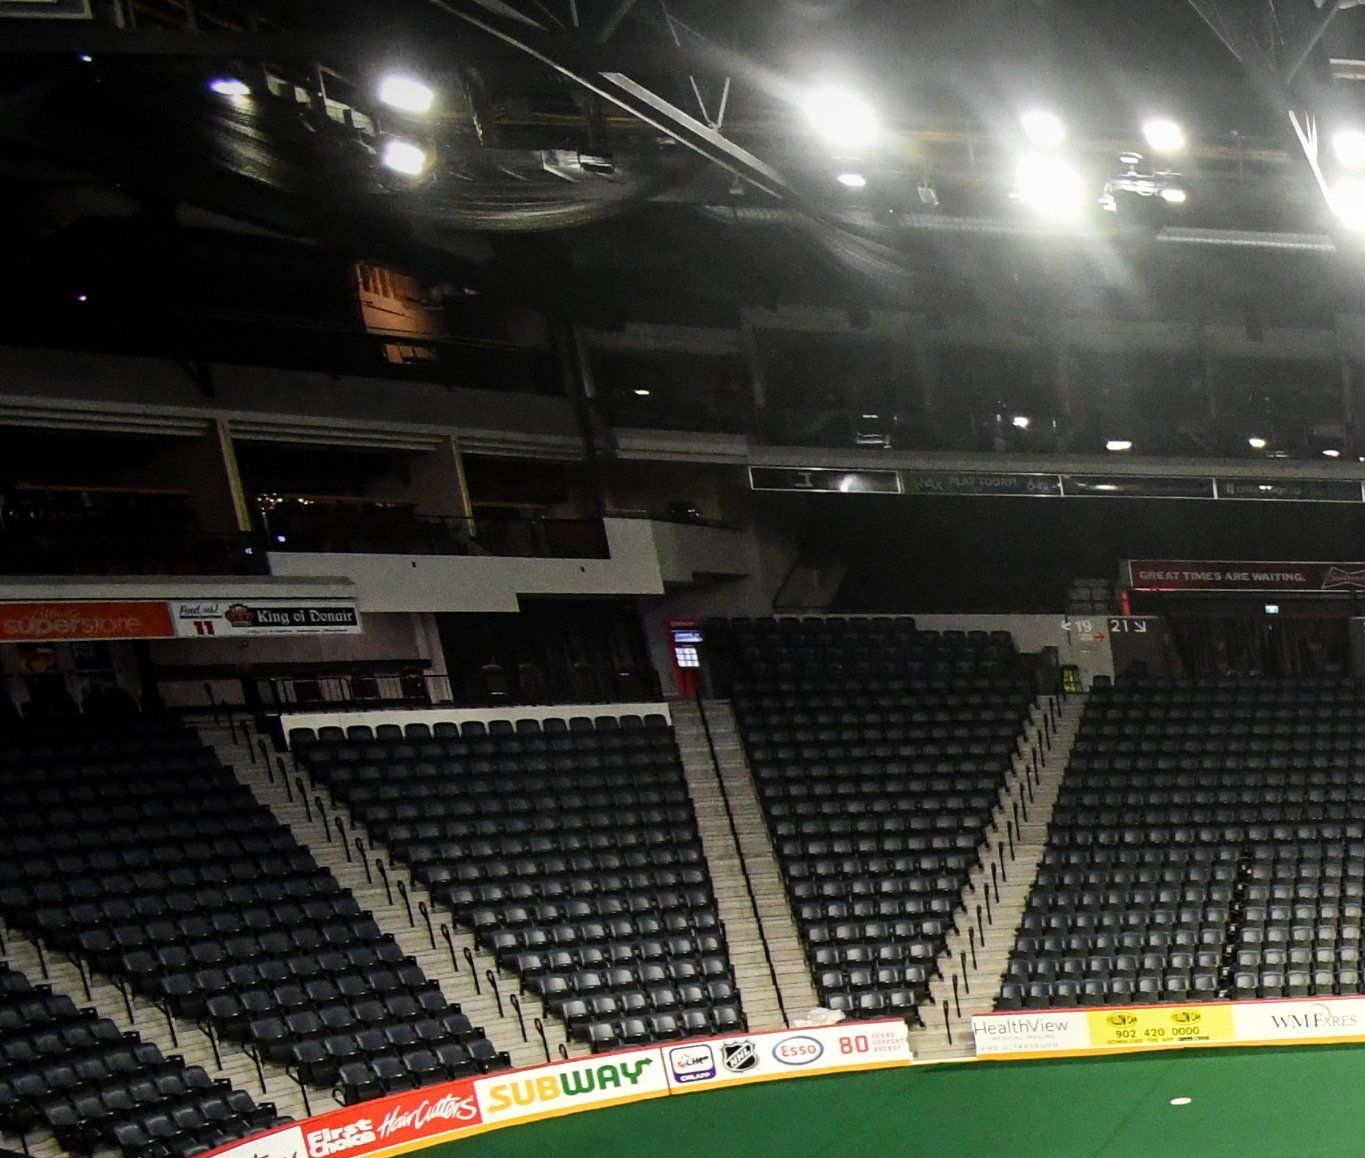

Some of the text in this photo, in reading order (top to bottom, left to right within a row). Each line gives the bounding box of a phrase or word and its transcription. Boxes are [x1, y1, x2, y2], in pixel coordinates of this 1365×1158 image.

[1139, 571, 1306, 582] GREAT TIMES ARE WAITING.
[257, 608, 354, 625] King of Donair
[193, 620, 216, 635] 11
[1074, 619, 1092, 632] 19
[1110, 619, 1129, 632] 21
[973, 1018, 1069, 1035] HealthView
[1115, 1026, 1200, 1038] 902 420 0000
[839, 1035, 869, 1055] 80
[730, 1045, 754, 1070] NHL
[487, 1057, 654, 1114] SUBWAY
[307, 1118, 374, 1147] First
[309, 1131, 377, 1158] Choice
